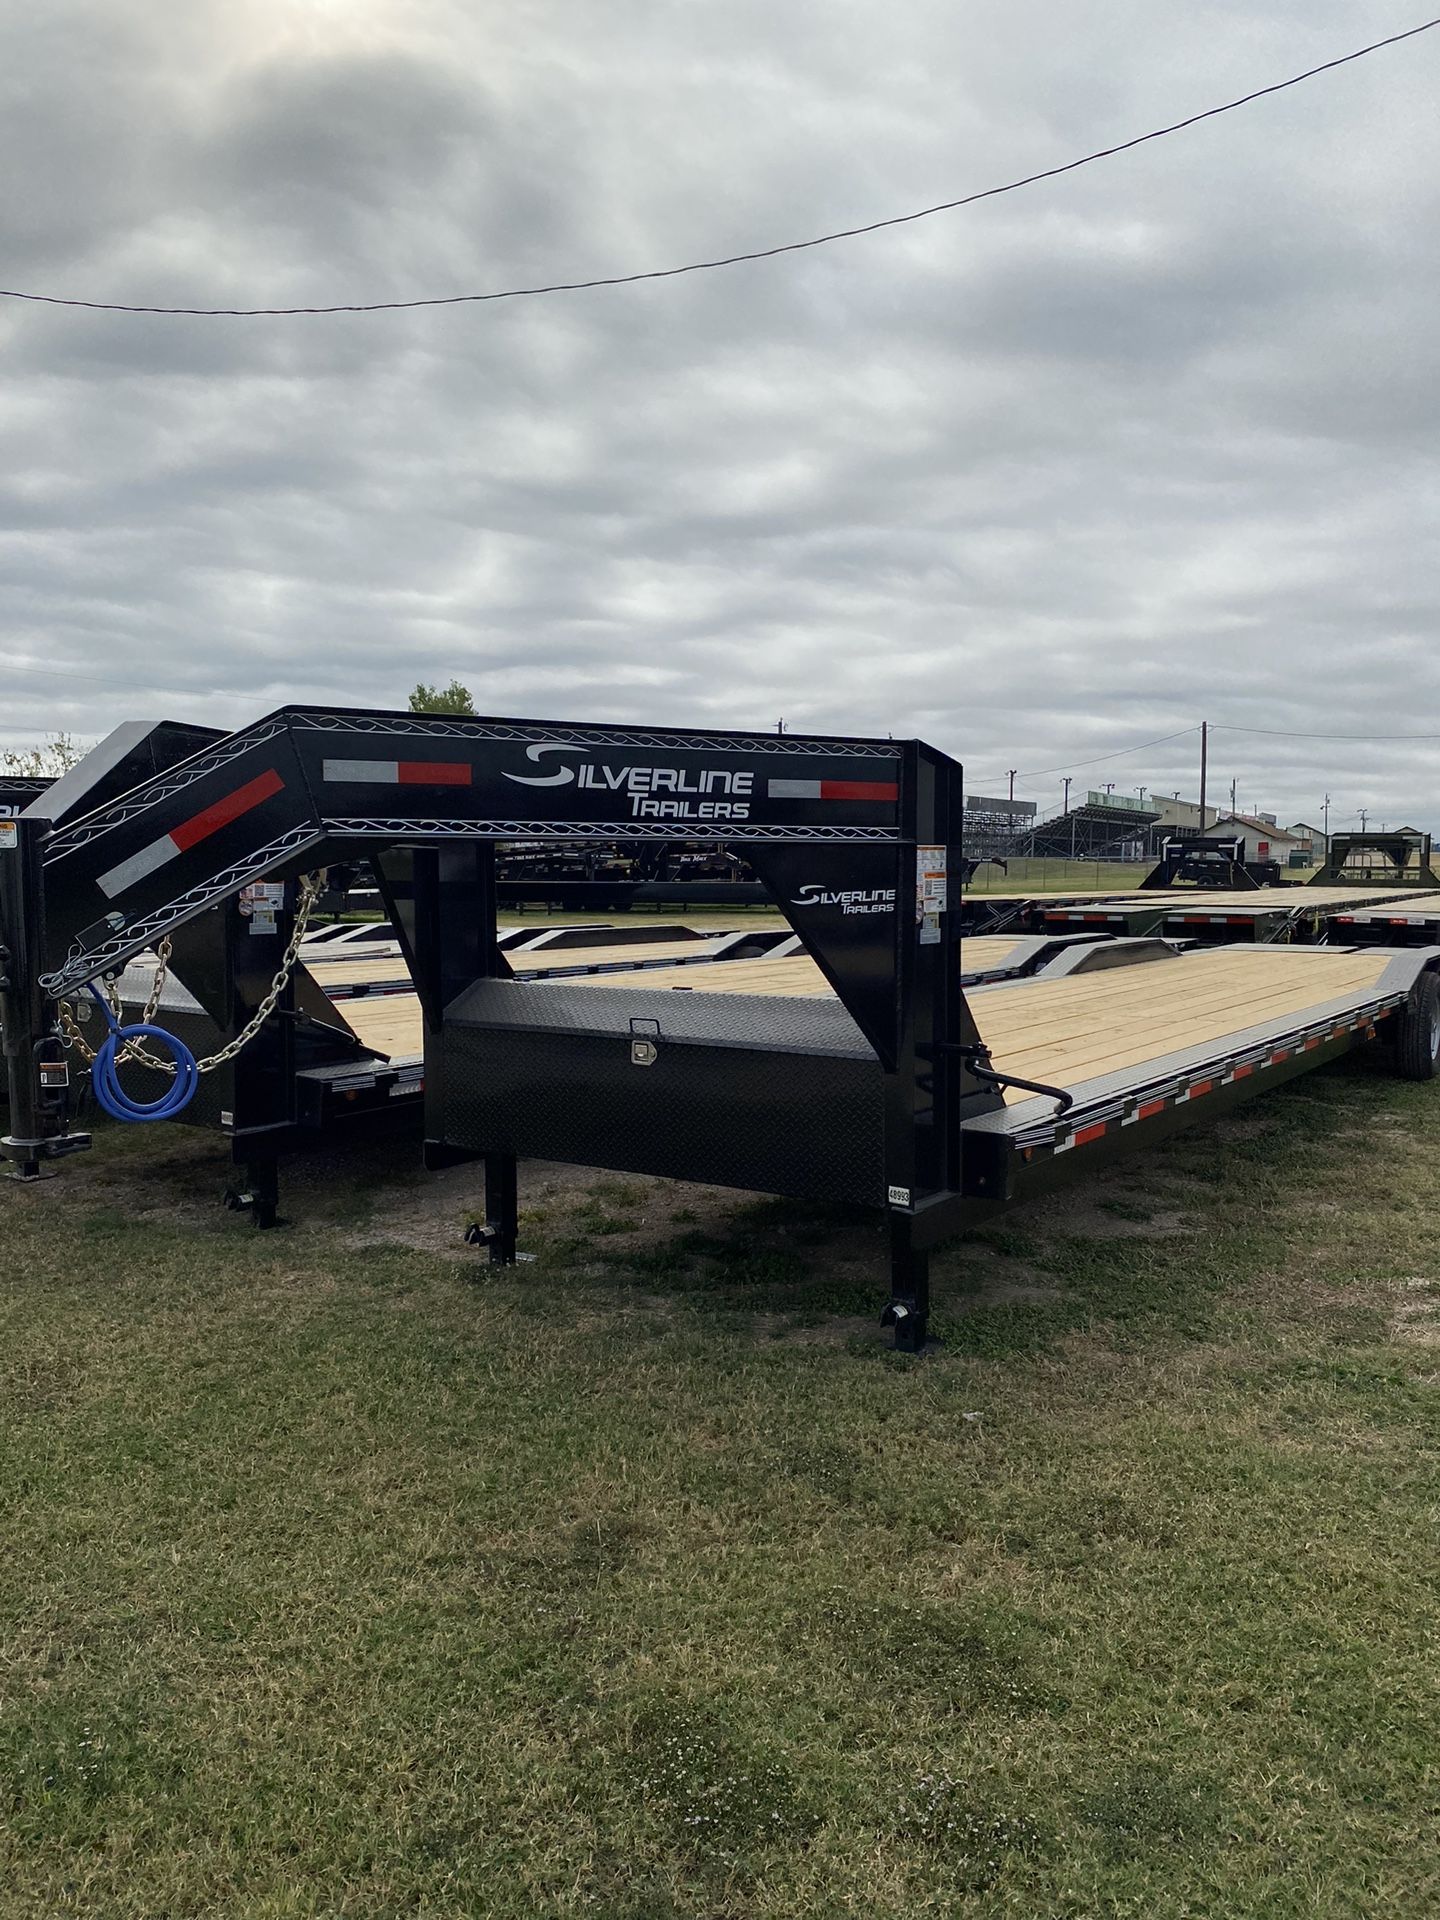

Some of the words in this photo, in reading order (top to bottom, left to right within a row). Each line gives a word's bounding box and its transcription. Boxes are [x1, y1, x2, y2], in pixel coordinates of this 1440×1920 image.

[502, 743, 756, 794] SILVERLINE
[627, 791, 752, 819] TRAILERS
[790, 884, 896, 906] SILVERLINE
[840, 902, 895, 916] TRAILERS
[889, 1189, 910, 1202] 48993
